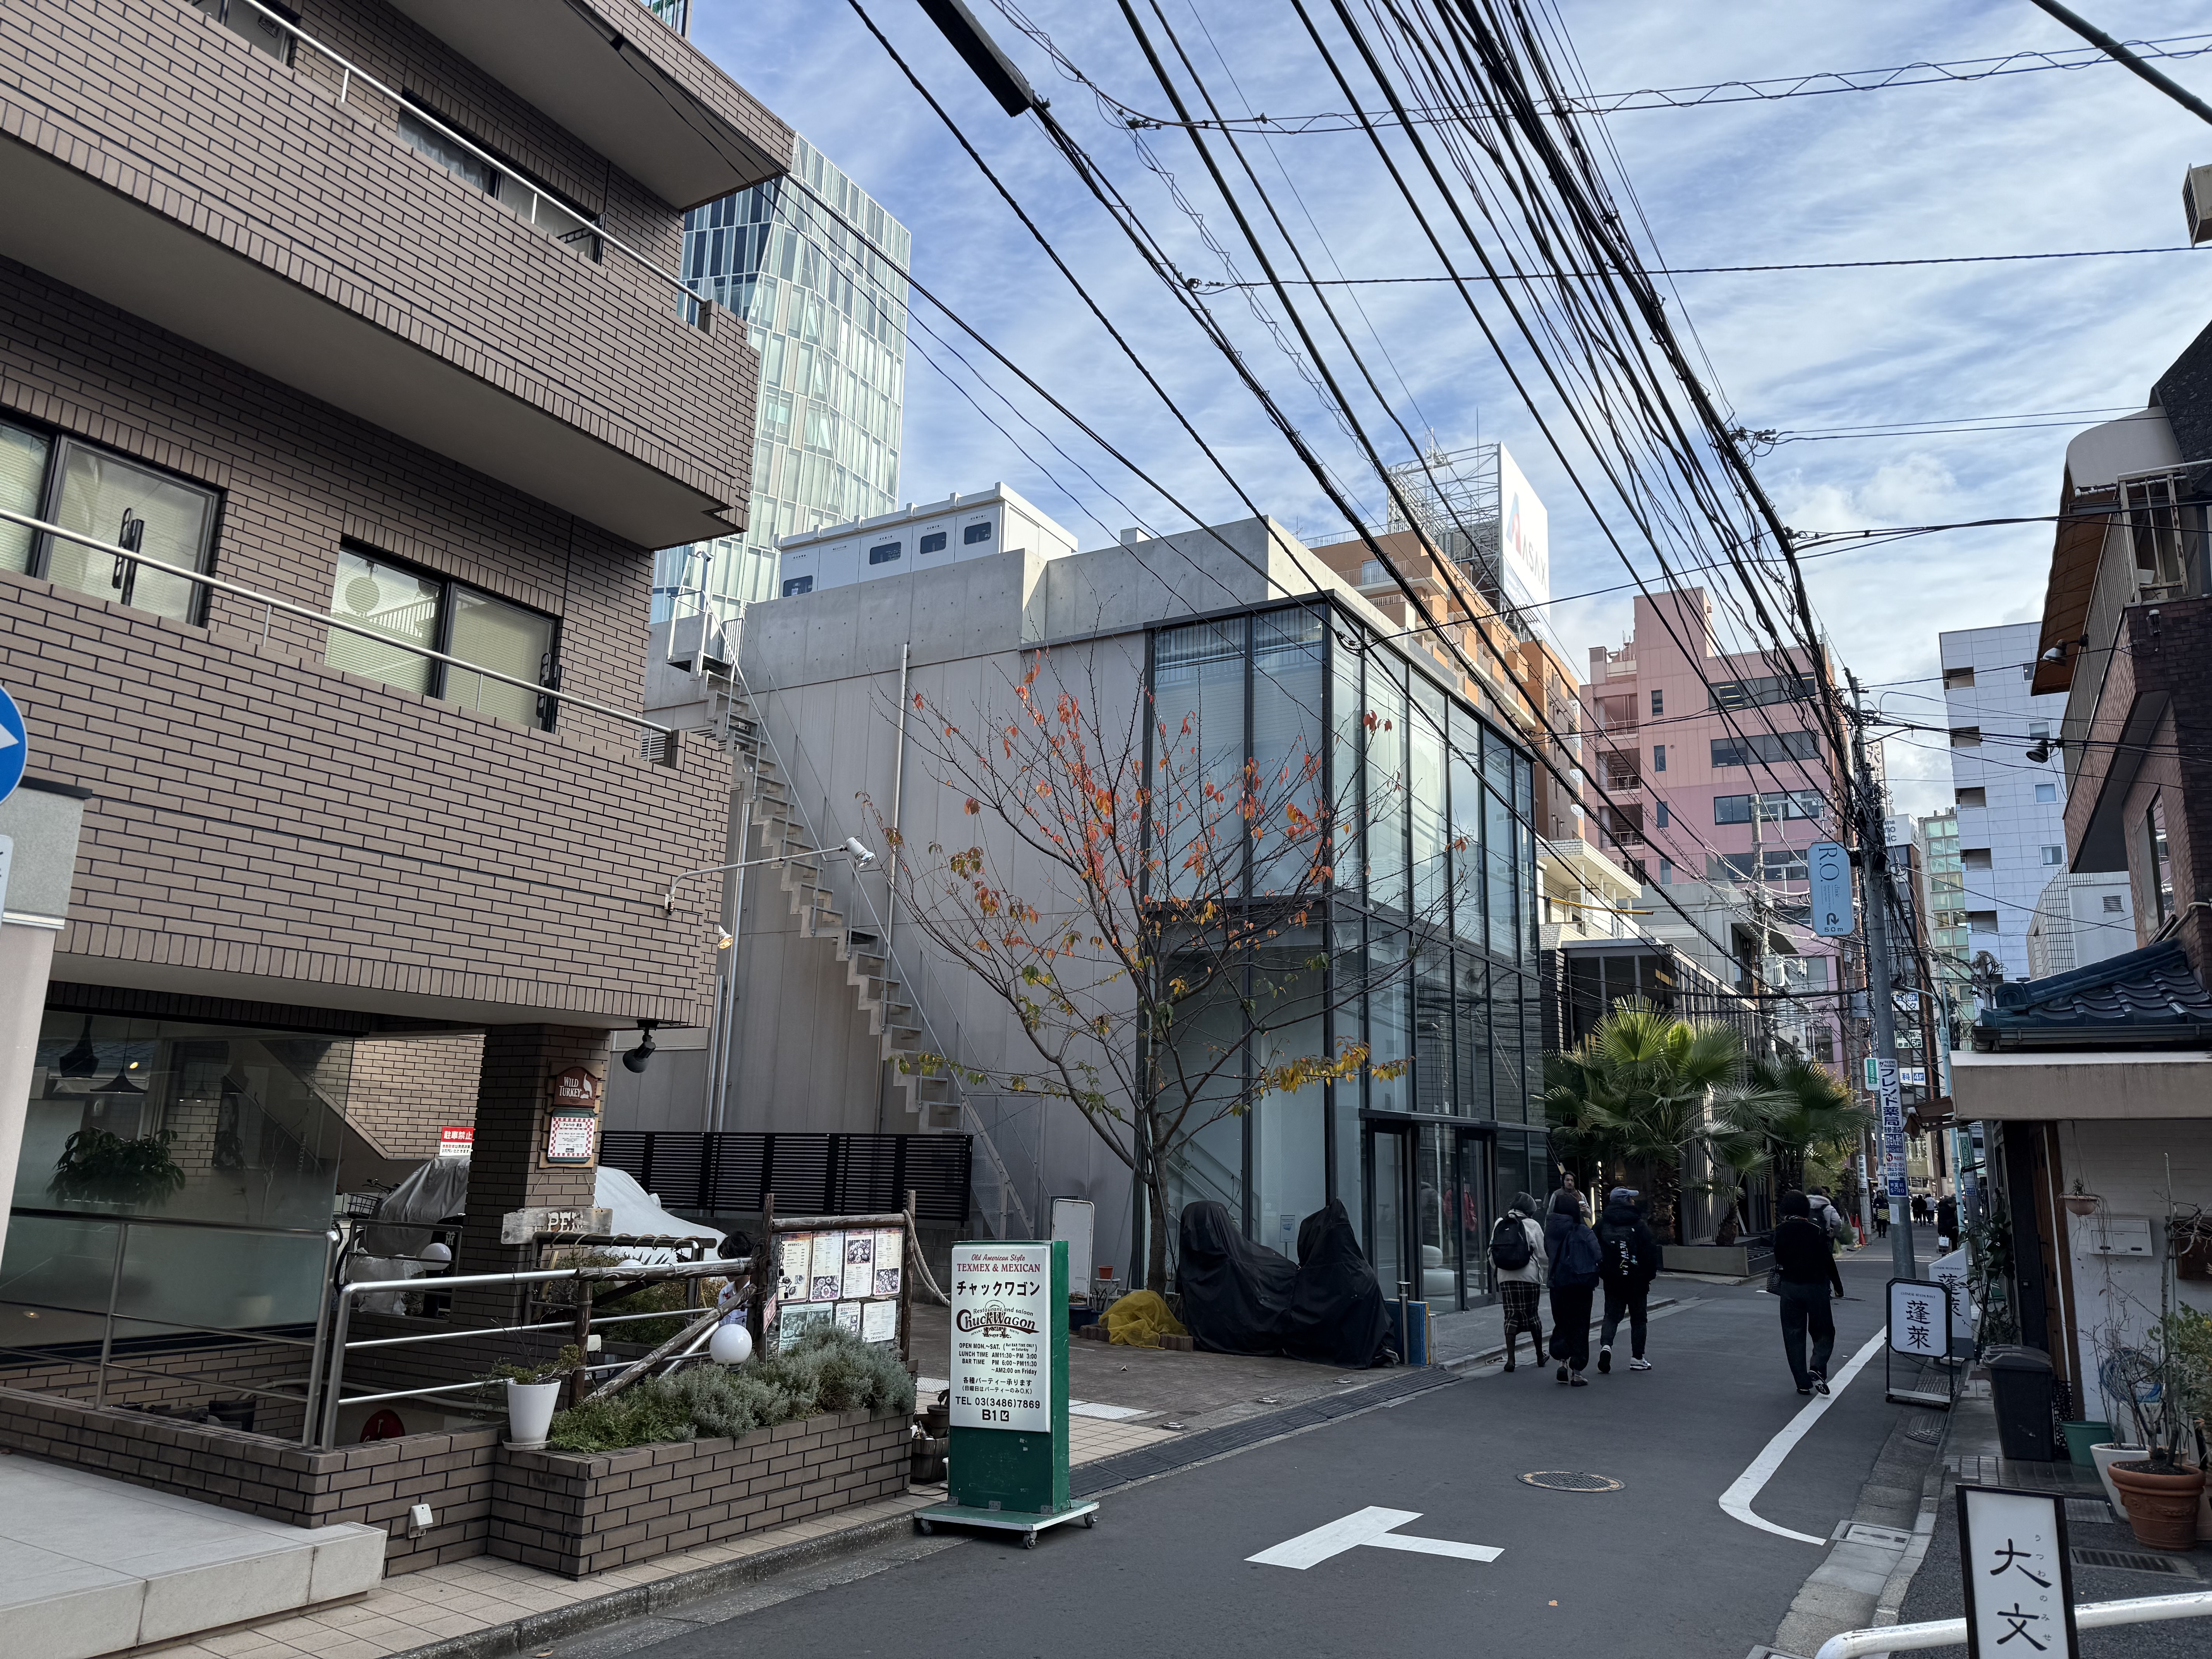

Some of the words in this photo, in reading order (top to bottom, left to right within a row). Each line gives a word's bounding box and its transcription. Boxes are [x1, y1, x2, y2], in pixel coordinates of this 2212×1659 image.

[1819, 846, 1839, 882] R.O.
[564, 1077, 579, 1087] WILD
[559, 1085, 582, 1097] TURKEY
[1881, 1069, 1899, 1126] フレンド薬局
[444, 1130, 472, 1140] 駐車禁止
[535, 1212, 583, 1232] PE
[1010, 1254, 1025, 1262] Style
[957, 1264, 990, 1272] TEXMEX
[992, 1264, 999, 1272] &
[1001, 1264, 1040, 1272] MEXICAN
[957, 1281, 1040, 1297] チャックワゴン
[963, 1377, 1032, 1386] 各種パーティー承ります
[955, 1396, 972, 1405] TEL
[975, 1397, 1040, 1409] 03(3486)7869
[982, 1409, 996, 1421] B1
[2035, 1534, 2052, 1641] うつわのみせ
